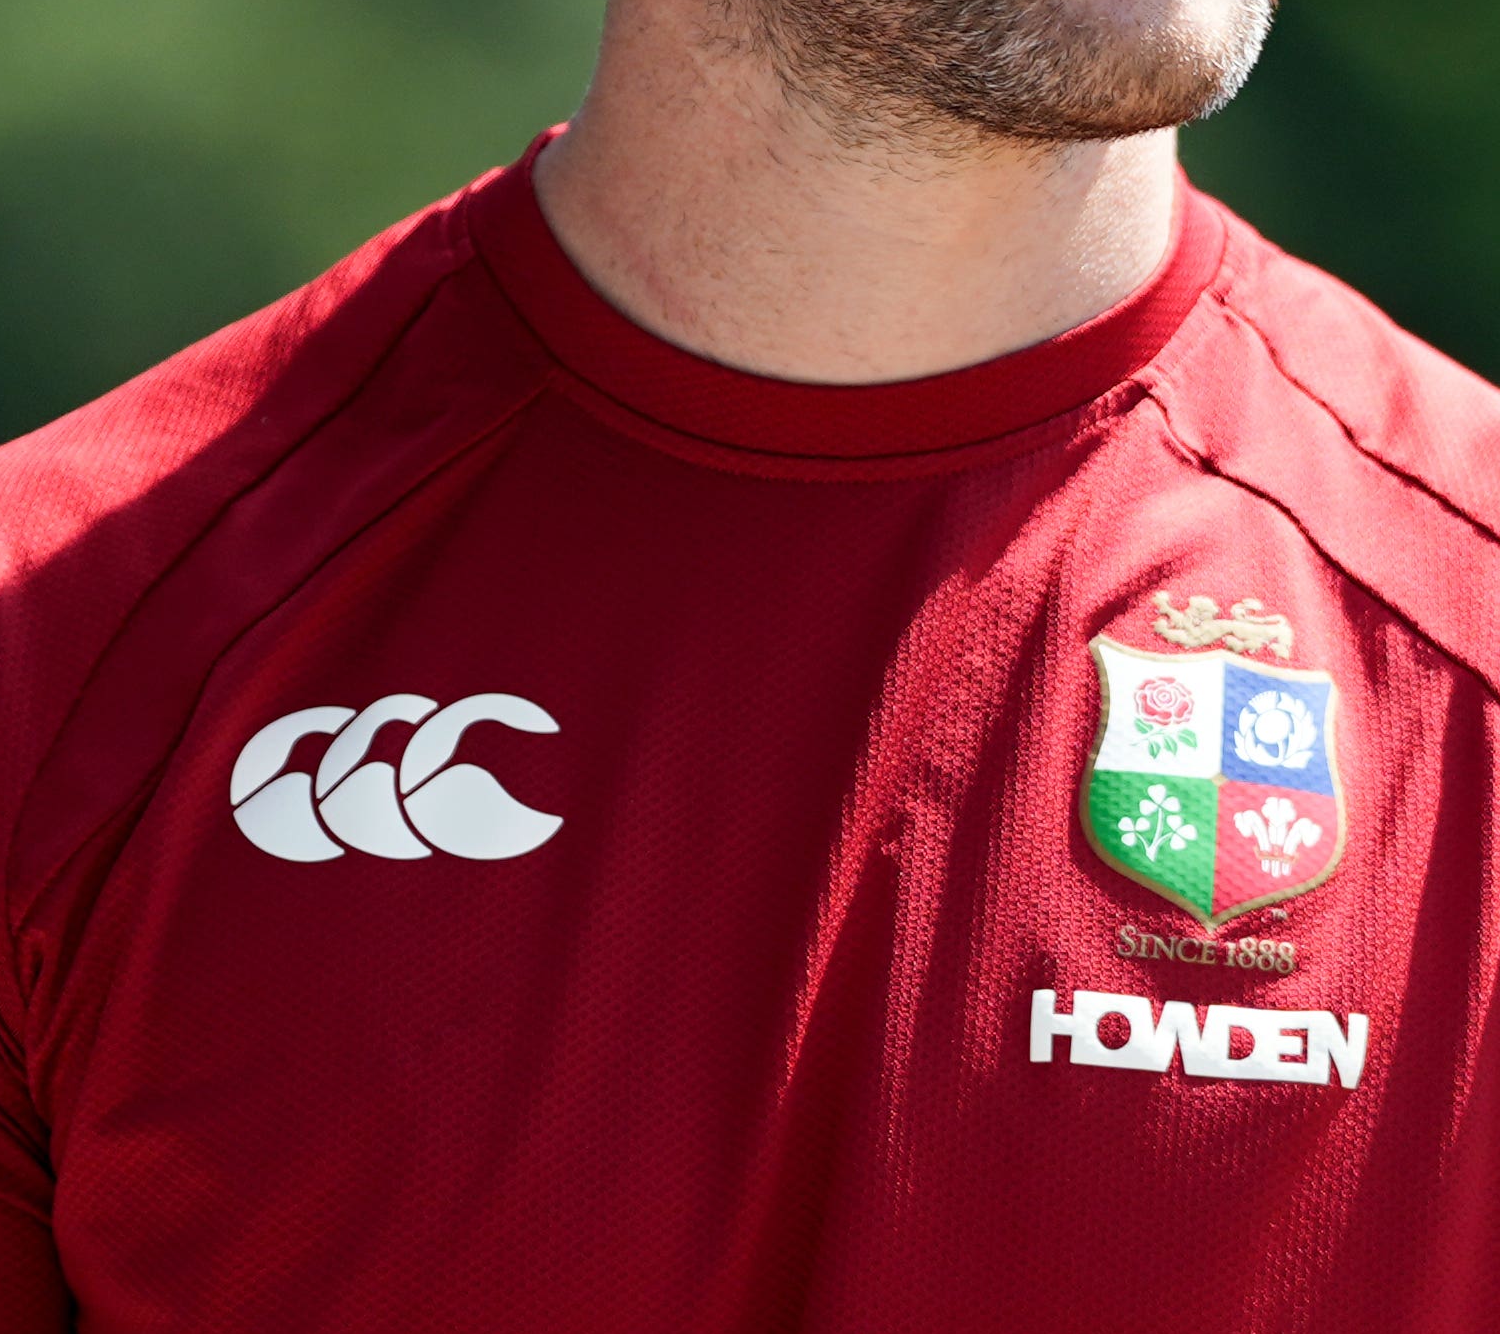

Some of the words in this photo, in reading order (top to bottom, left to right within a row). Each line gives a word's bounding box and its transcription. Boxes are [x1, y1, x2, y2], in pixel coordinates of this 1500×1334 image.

[1117, 924, 1218, 965] SINCE
[1223, 937, 1296, 974] 1888
[1029, 988, 1369, 1090] HOWDEN
